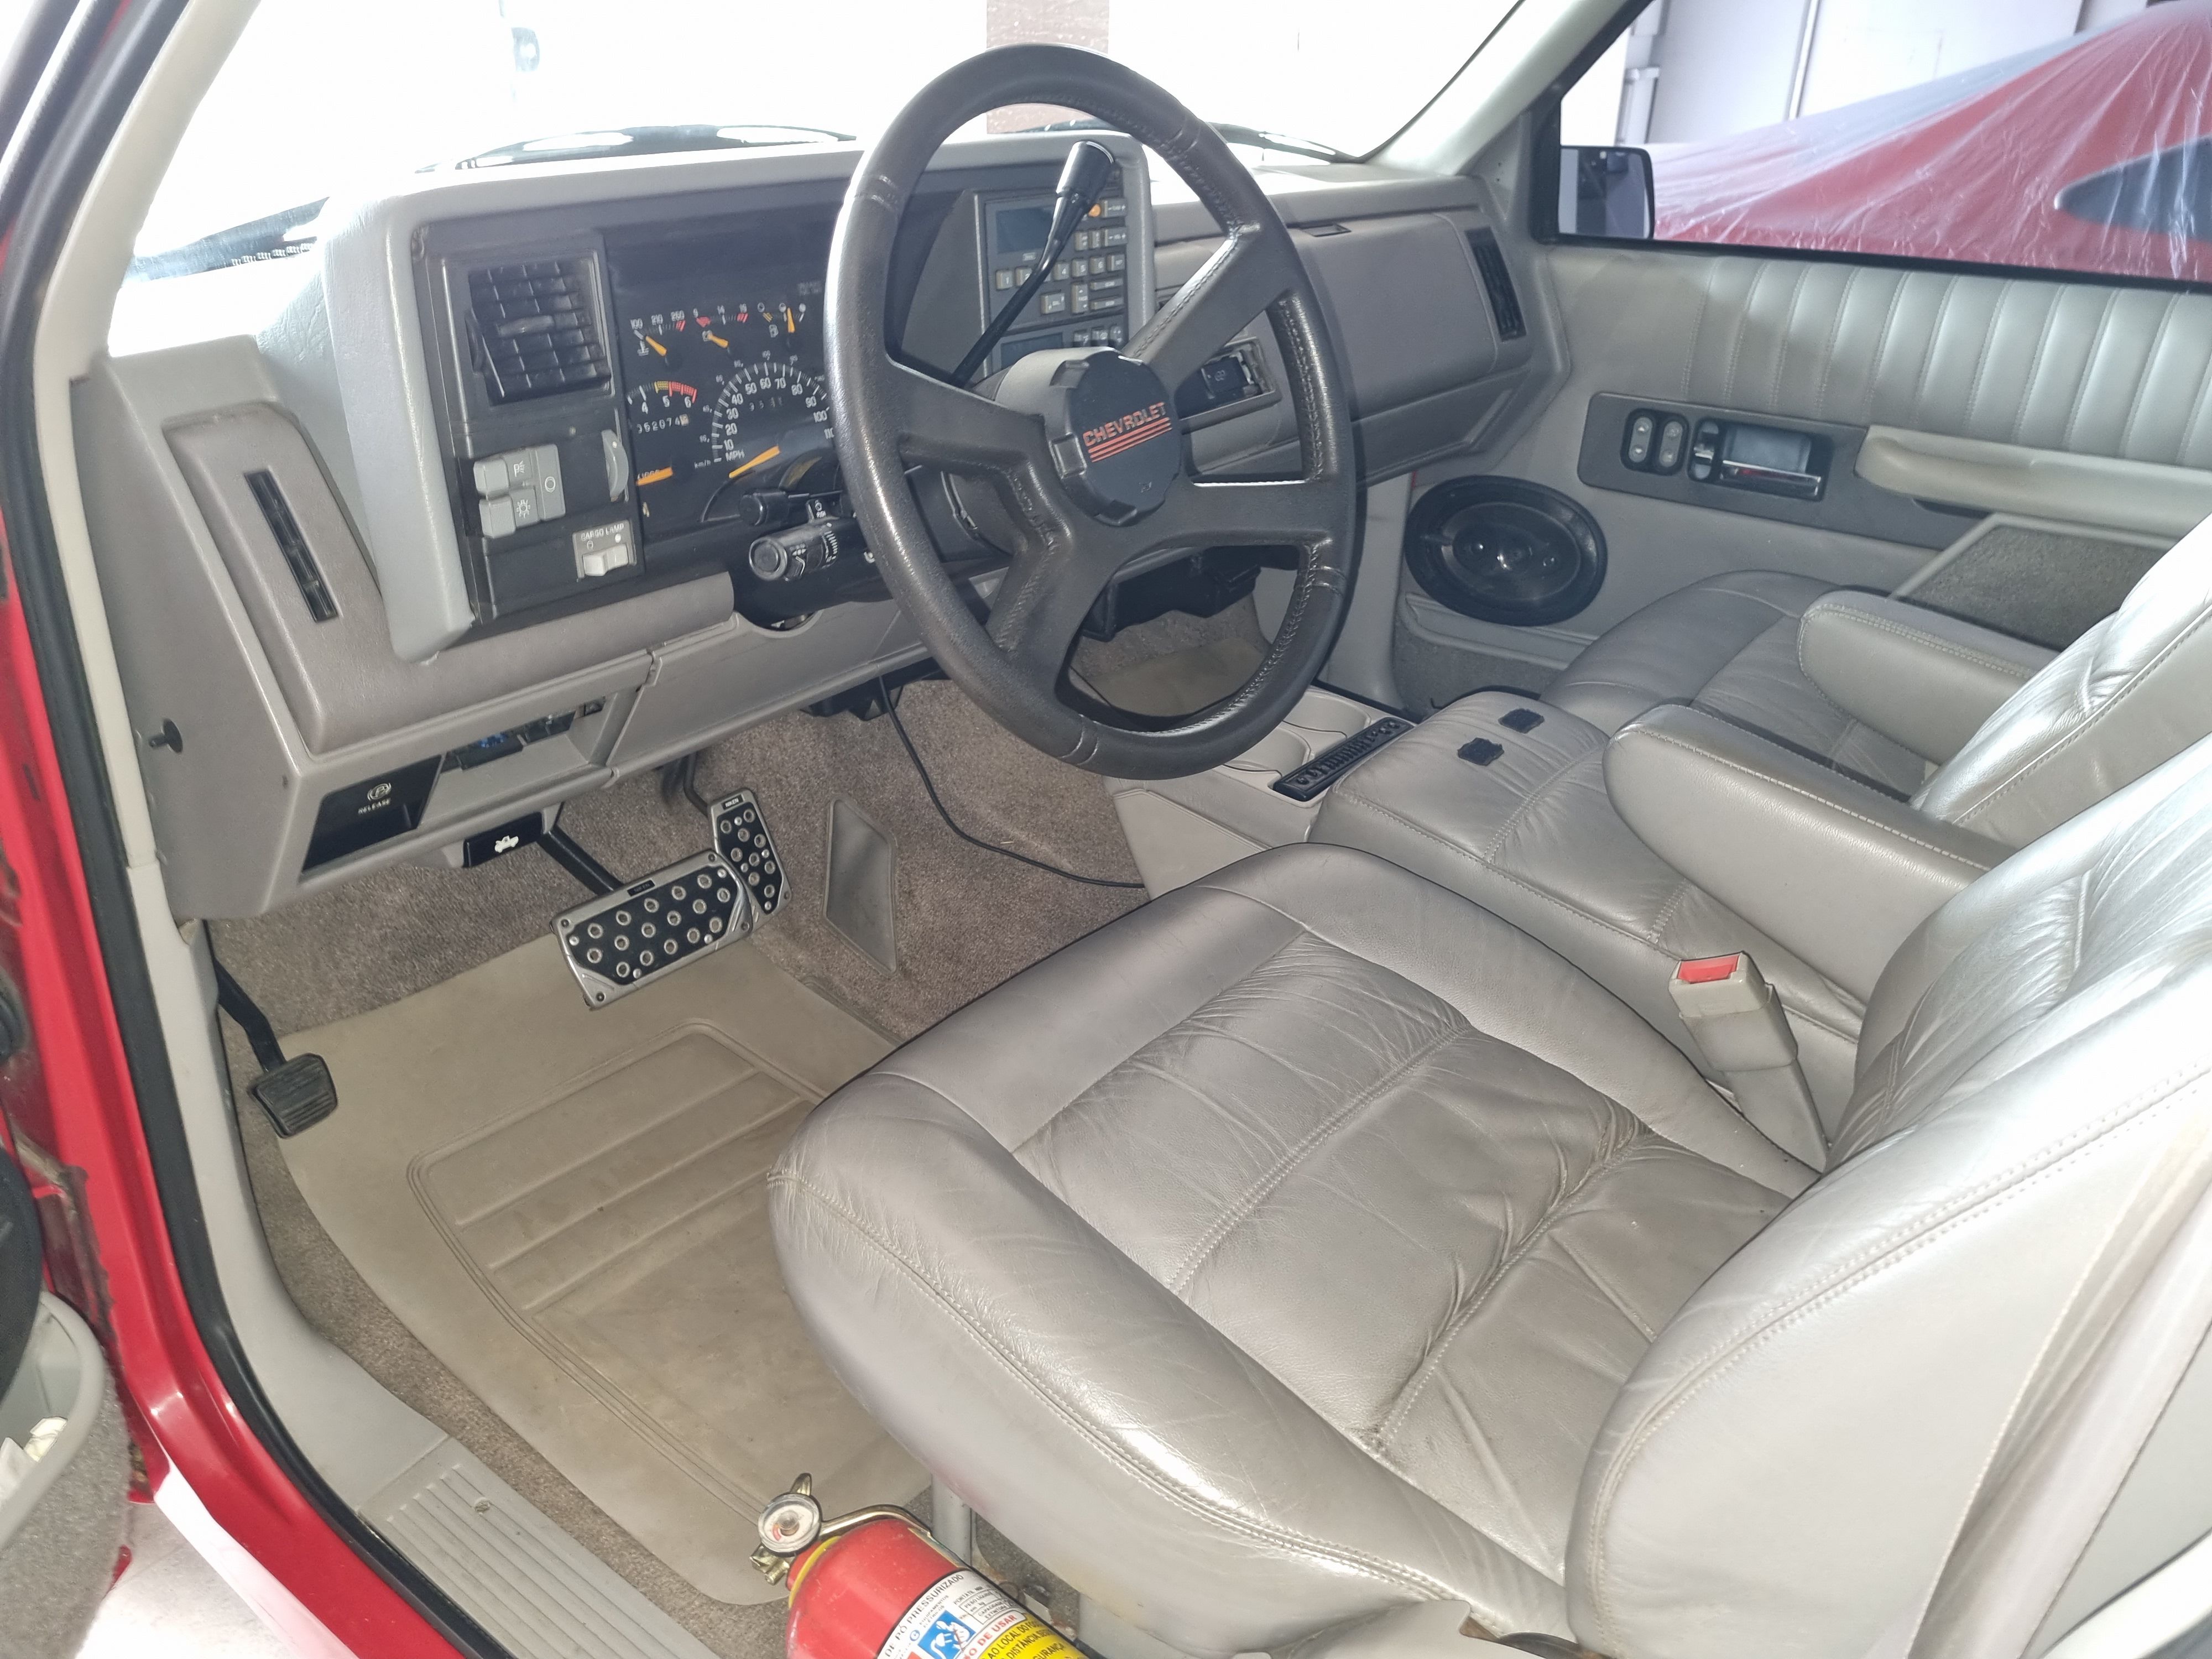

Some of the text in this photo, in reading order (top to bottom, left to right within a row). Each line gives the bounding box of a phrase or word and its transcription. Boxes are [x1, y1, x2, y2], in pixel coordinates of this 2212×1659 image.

[745, 382, 758, 395] 50
[759, 377, 771, 389] 60
[775, 377, 787, 390] 70
[662, 395, 670, 408] 5
[684, 396, 692, 408] 6
[731, 393, 744, 405] 40
[805, 395, 817, 408] 90
[726, 407, 739, 420] 30
[725, 422, 738, 436] 20
[1082, 401, 1167, 447] CHEVROLET
[723, 439, 734, 451] 10
[725, 448, 745, 462] MPH
[581, 523, 625, 542] CARGO LAMP
[895, 1624, 908, 1641] PÓ
[906, 1574, 964, 1624] PRESSURIZADO
[977, 1632, 993, 1647] DE
[991, 1614, 1018, 1632] USAR
[997, 1630, 1021, 1650] LOCAL
[1018, 1623, 1030, 1634] DO
